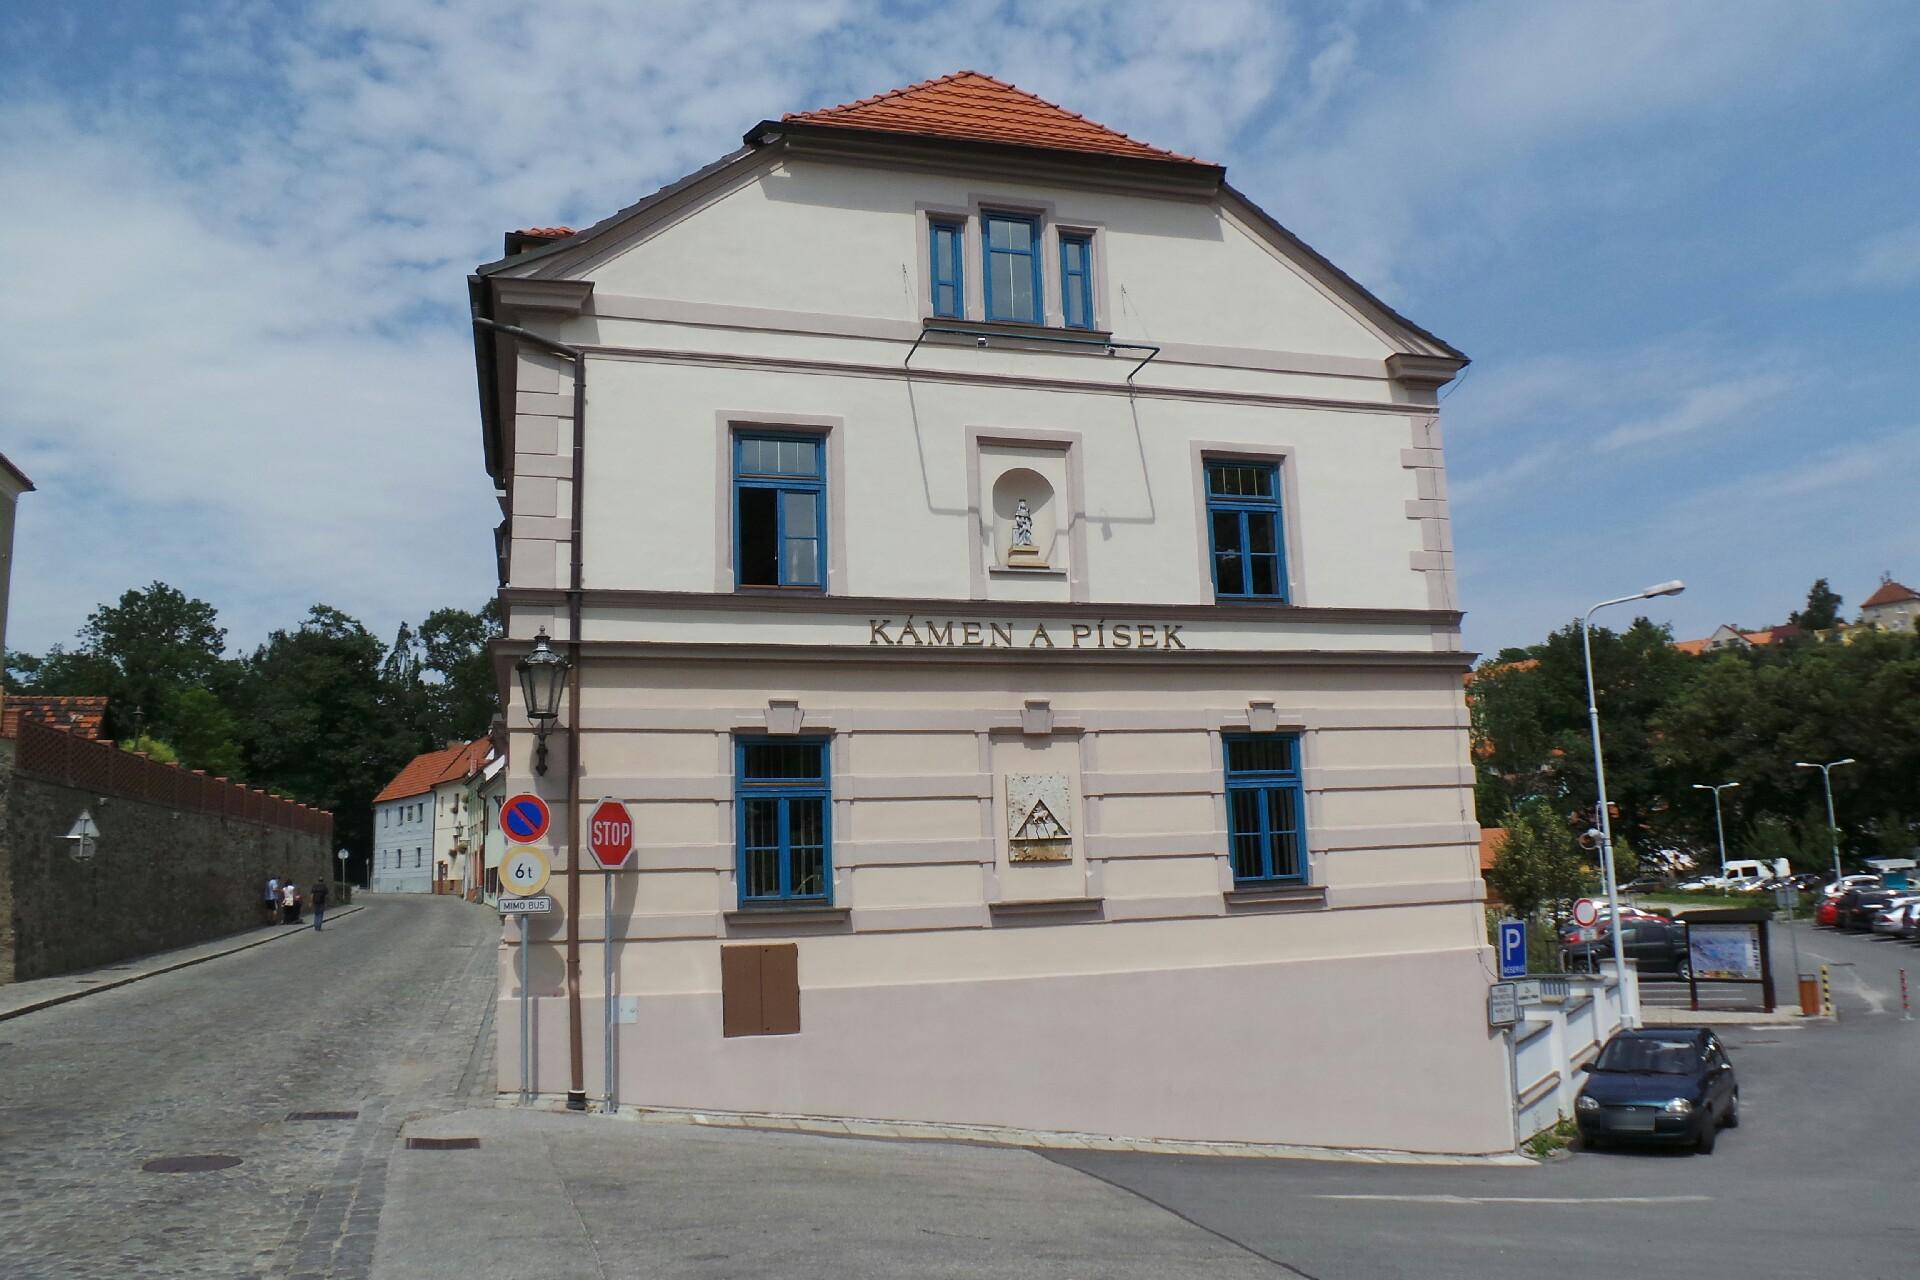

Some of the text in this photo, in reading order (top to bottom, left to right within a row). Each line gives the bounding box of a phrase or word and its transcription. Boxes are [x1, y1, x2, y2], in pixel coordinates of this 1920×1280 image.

[869, 614, 1186, 649] KÁMEN A PÍSEK
[593, 820, 630, 846] STOP
[503, 901, 545, 910] MIMO BUS
[1505, 928, 1521, 961] P
